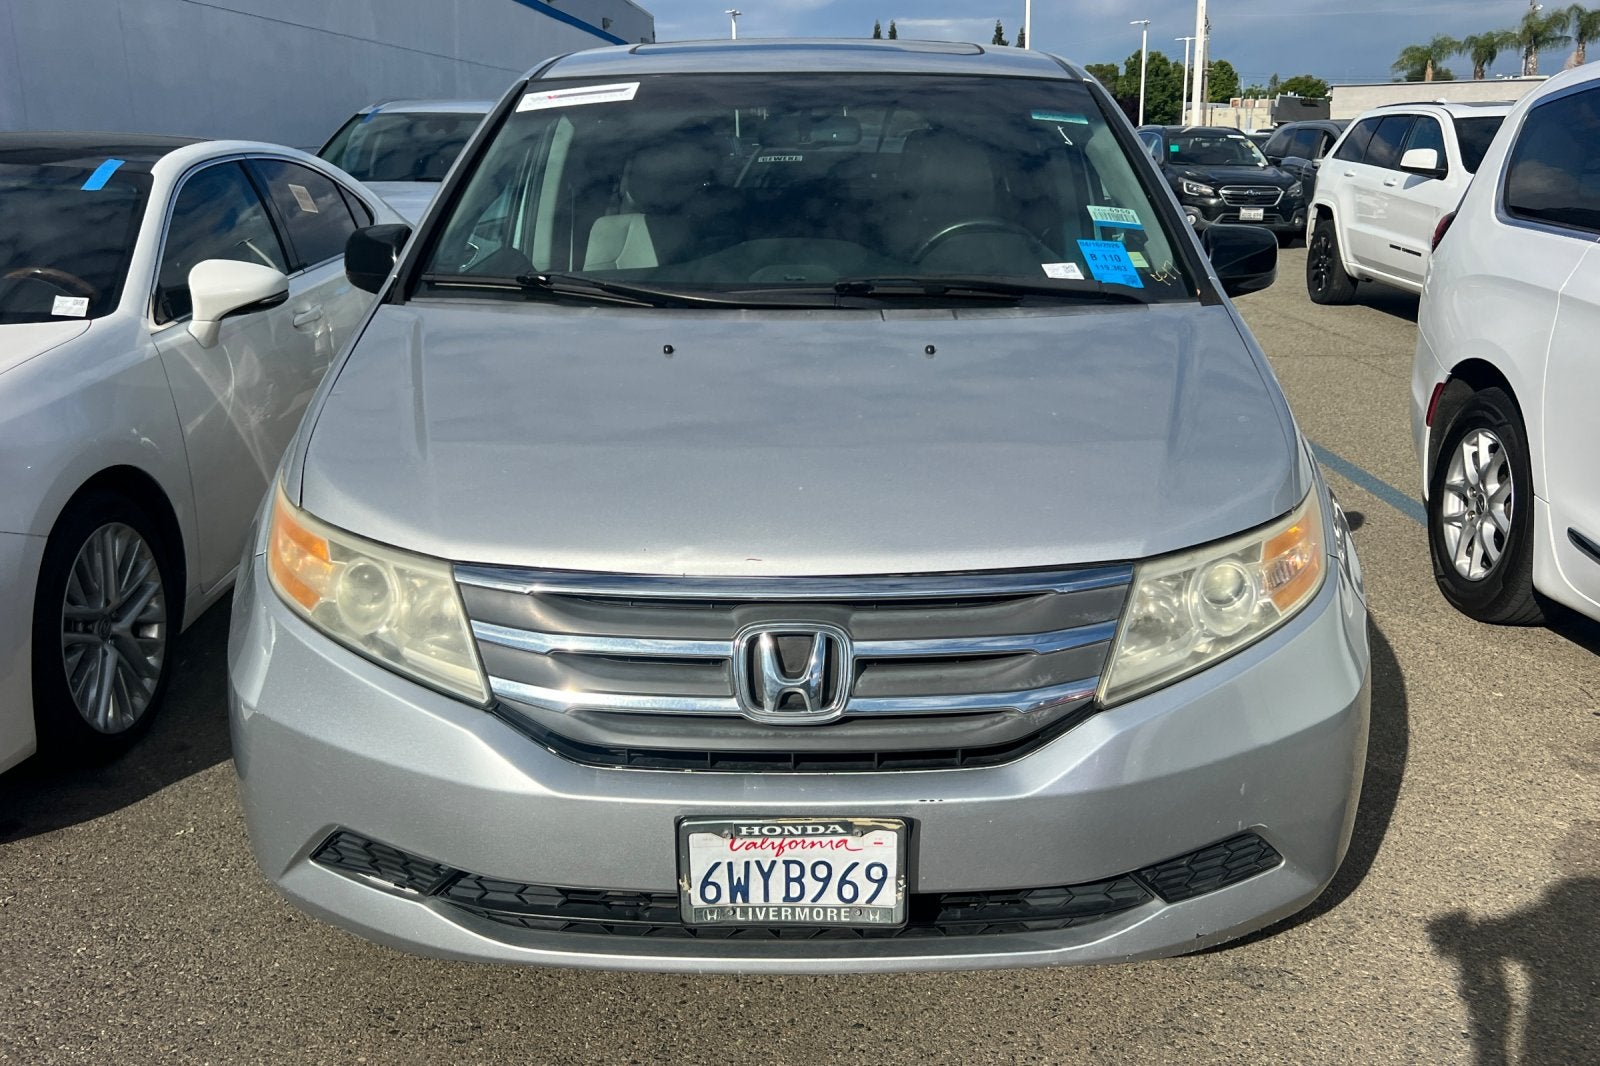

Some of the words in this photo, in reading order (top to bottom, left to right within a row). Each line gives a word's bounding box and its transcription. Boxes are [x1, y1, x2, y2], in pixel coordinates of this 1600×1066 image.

[1102, 254, 1121, 262] 110
[738, 824, 848, 836] HONDA
[729, 837, 863, 857] California
[699, 859, 889, 905] 6WYB969
[736, 907, 851, 922] LIVERMORE
